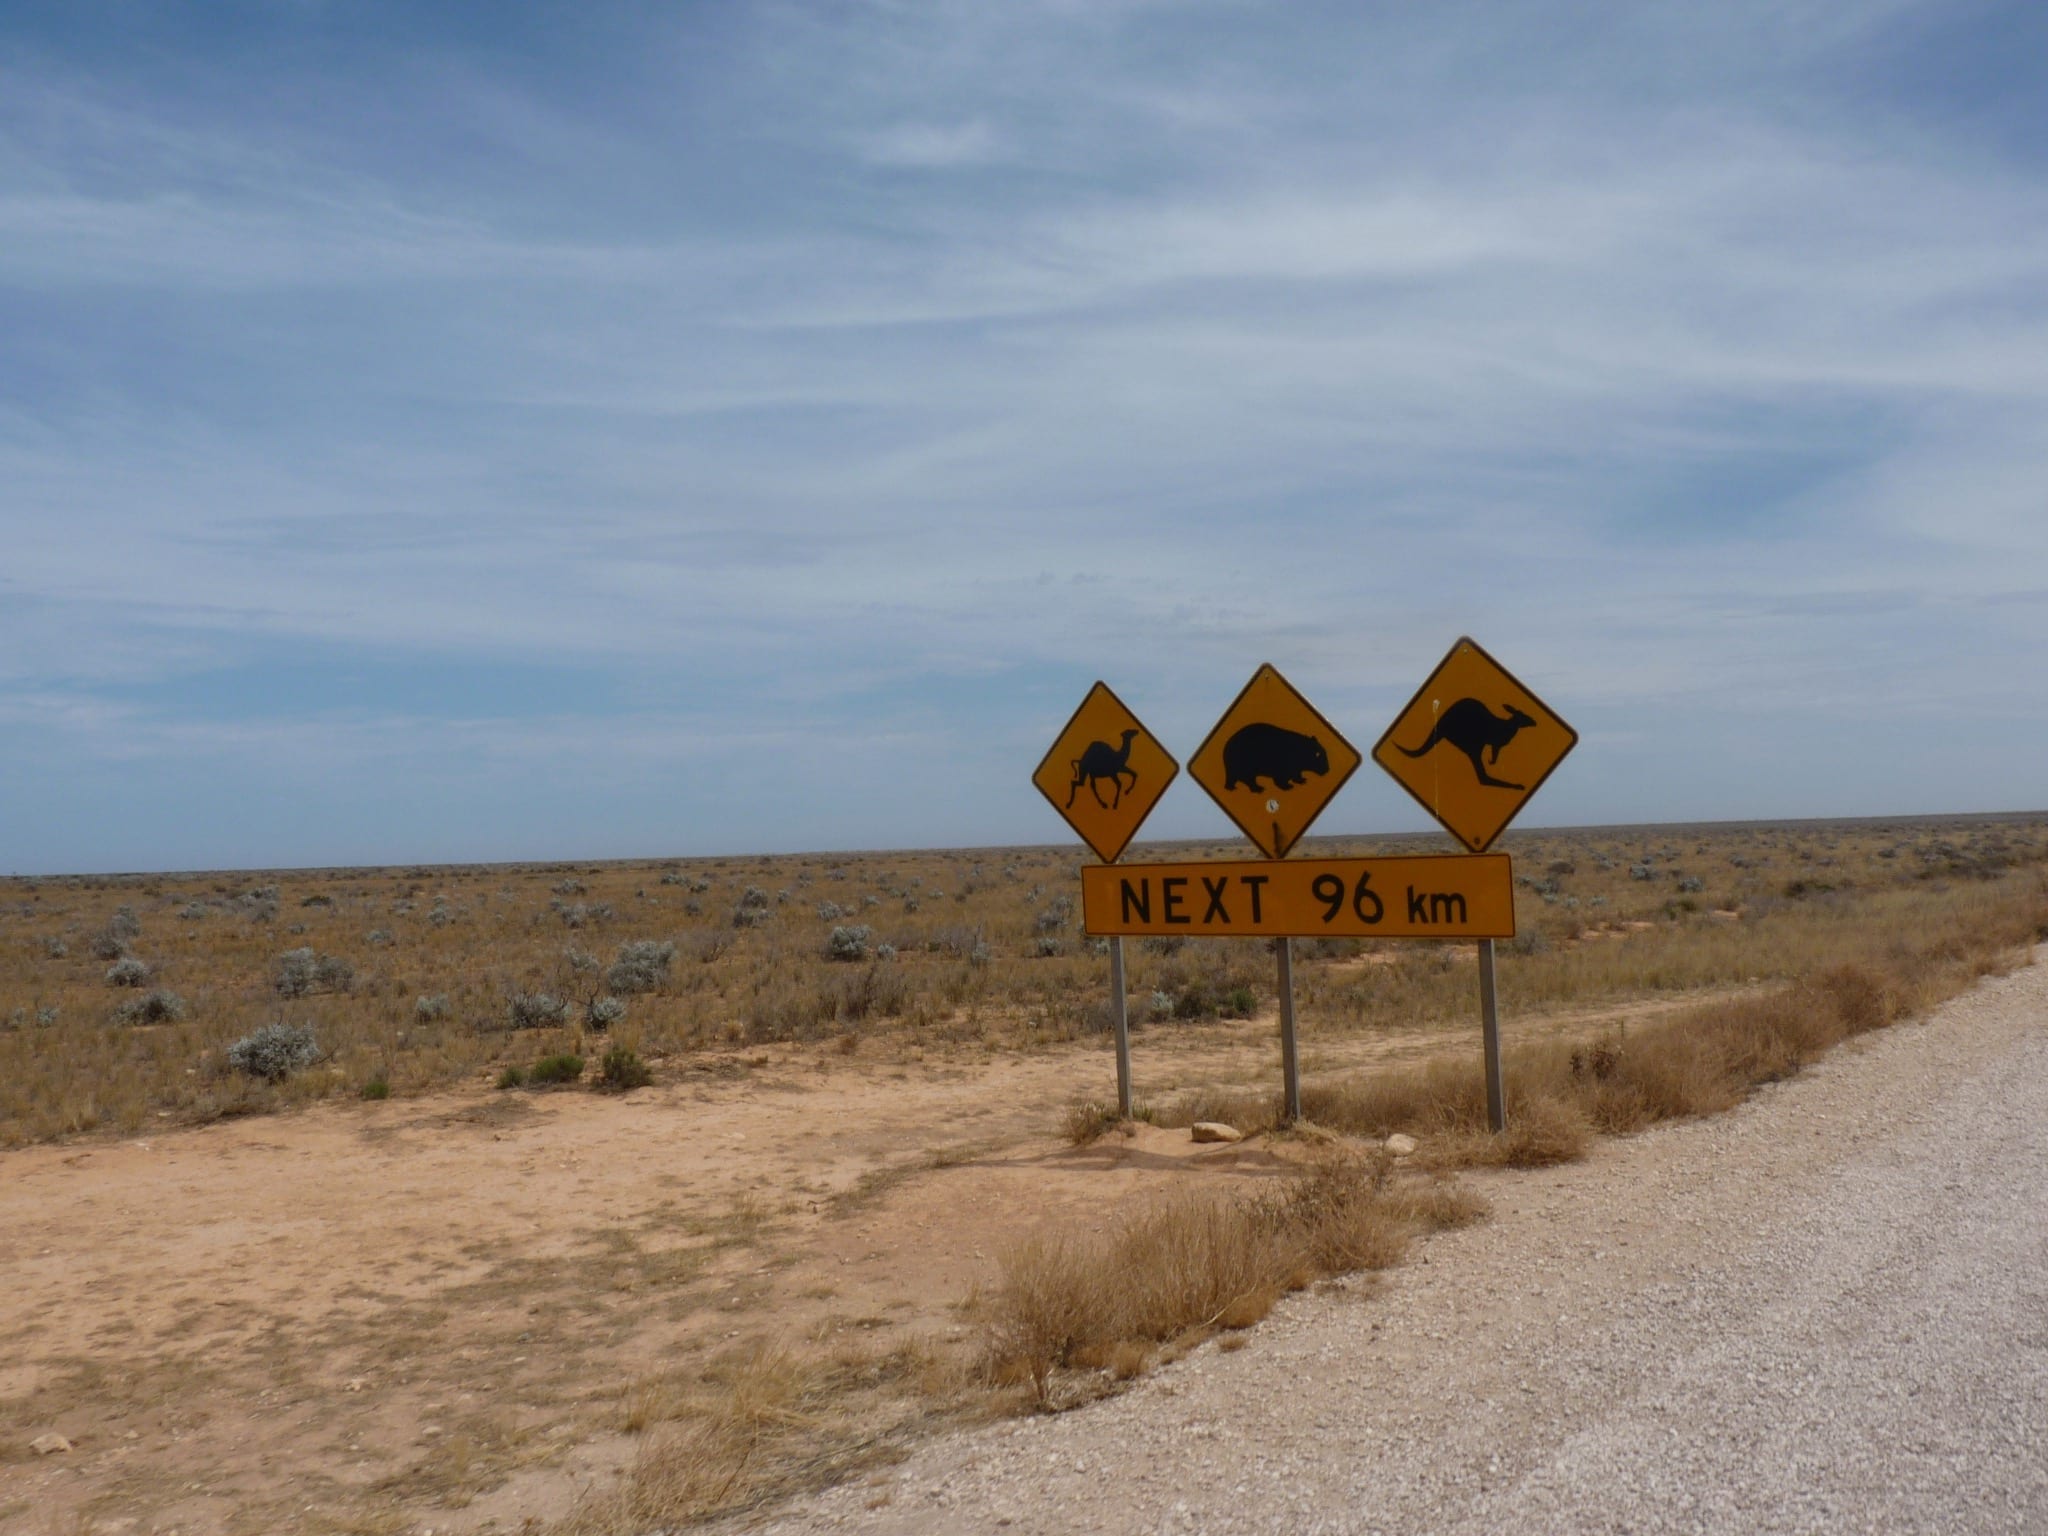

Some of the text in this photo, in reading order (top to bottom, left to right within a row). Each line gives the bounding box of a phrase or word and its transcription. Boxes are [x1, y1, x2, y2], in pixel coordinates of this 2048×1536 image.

[1120, 870, 1468, 926] NEXT 96 km
